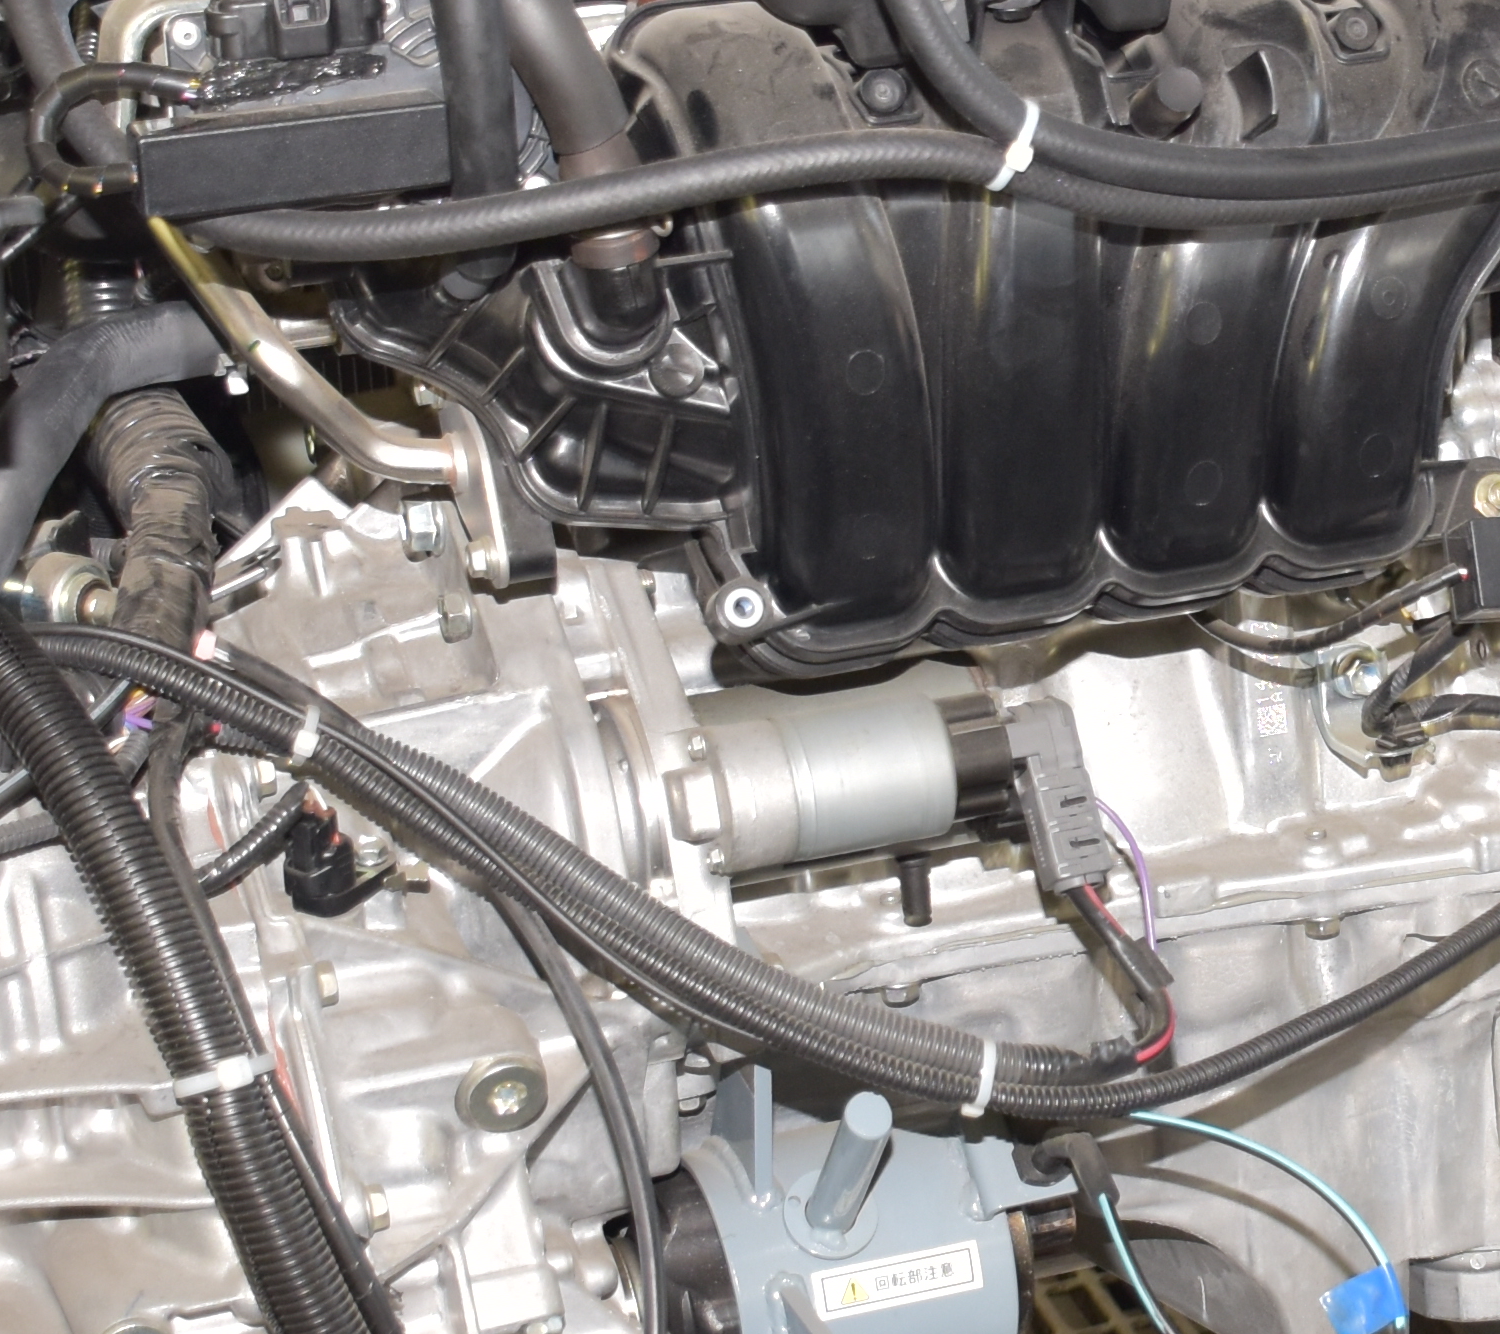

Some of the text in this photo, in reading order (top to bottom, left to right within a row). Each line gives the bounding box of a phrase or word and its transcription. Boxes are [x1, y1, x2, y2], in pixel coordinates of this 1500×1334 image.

[875, 1261, 955, 1292] 回転部注意
